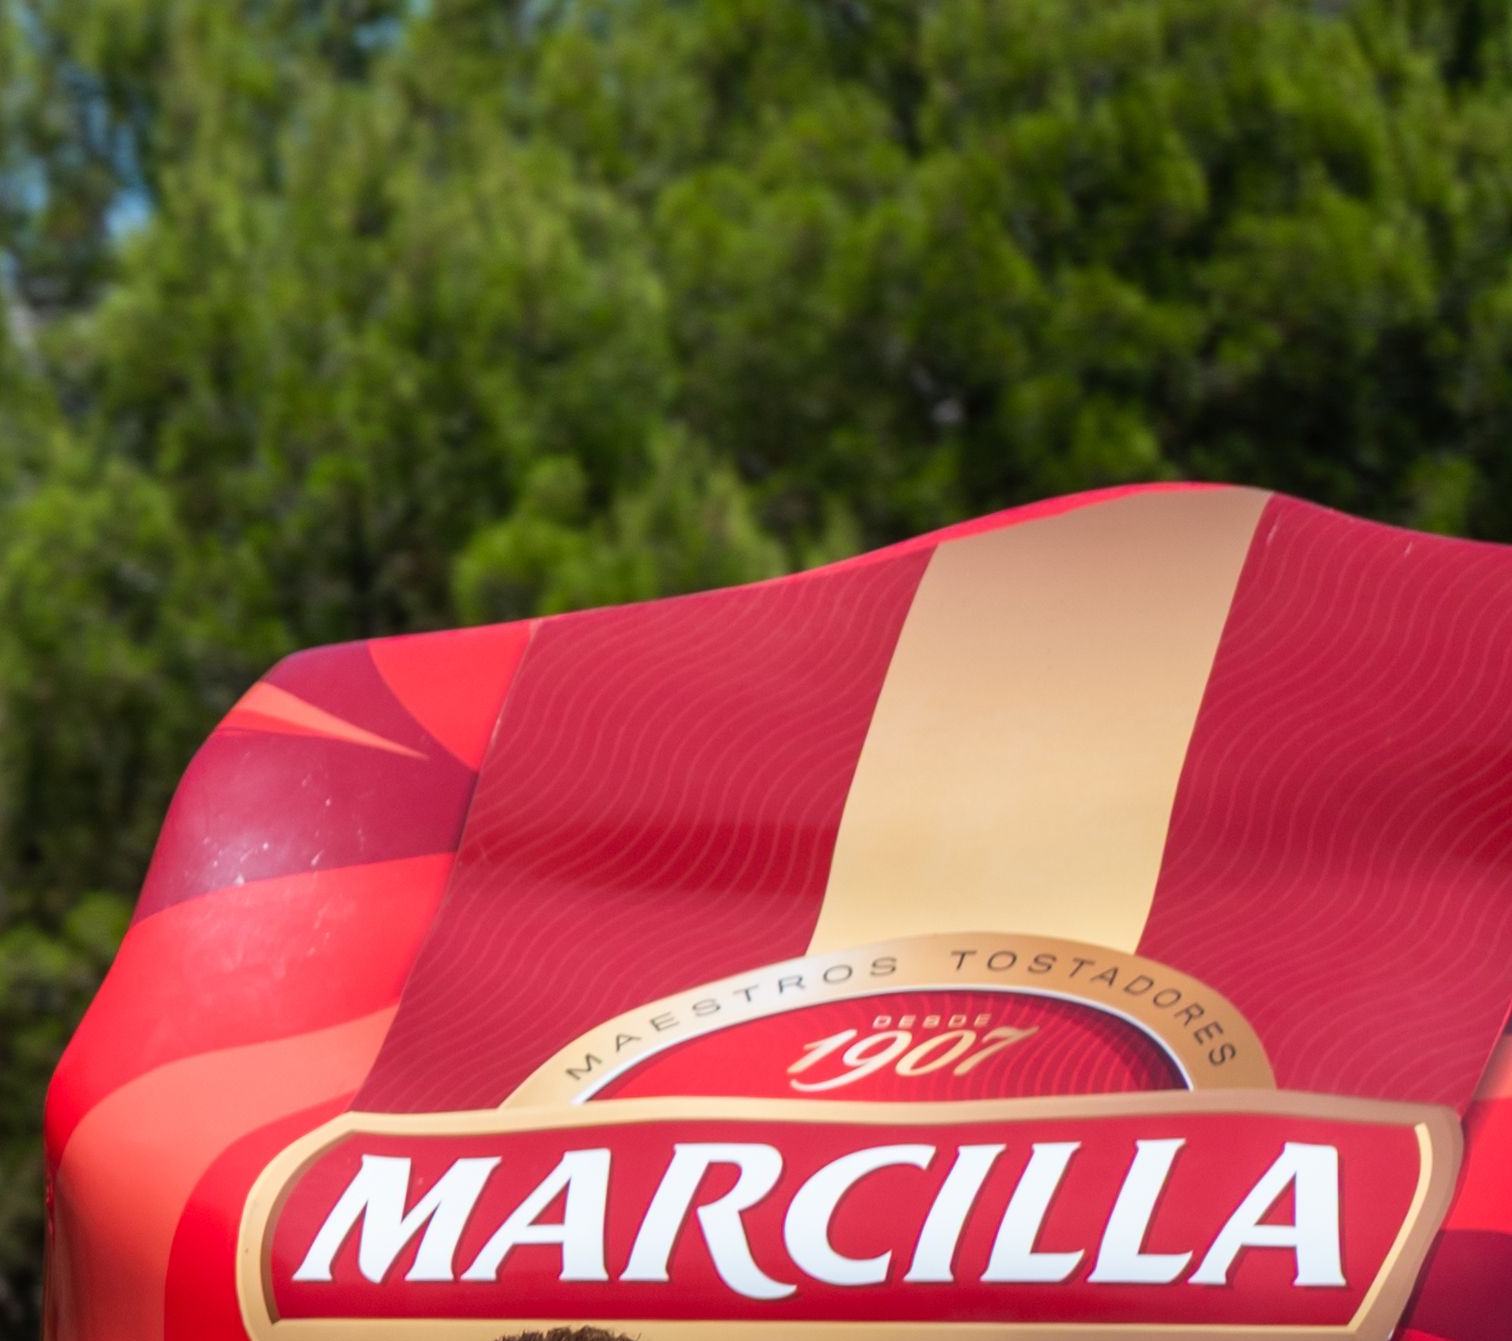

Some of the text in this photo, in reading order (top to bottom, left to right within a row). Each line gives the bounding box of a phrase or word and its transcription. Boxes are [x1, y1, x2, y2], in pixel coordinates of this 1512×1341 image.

[566, 950, 1237, 1080] MAESTROS TOSTADORES
[786, 1025, 1040, 1093] 1907
[873, 1013, 992, 1029] DESDE
[292, 1139, 1347, 1301] MARCILLA
